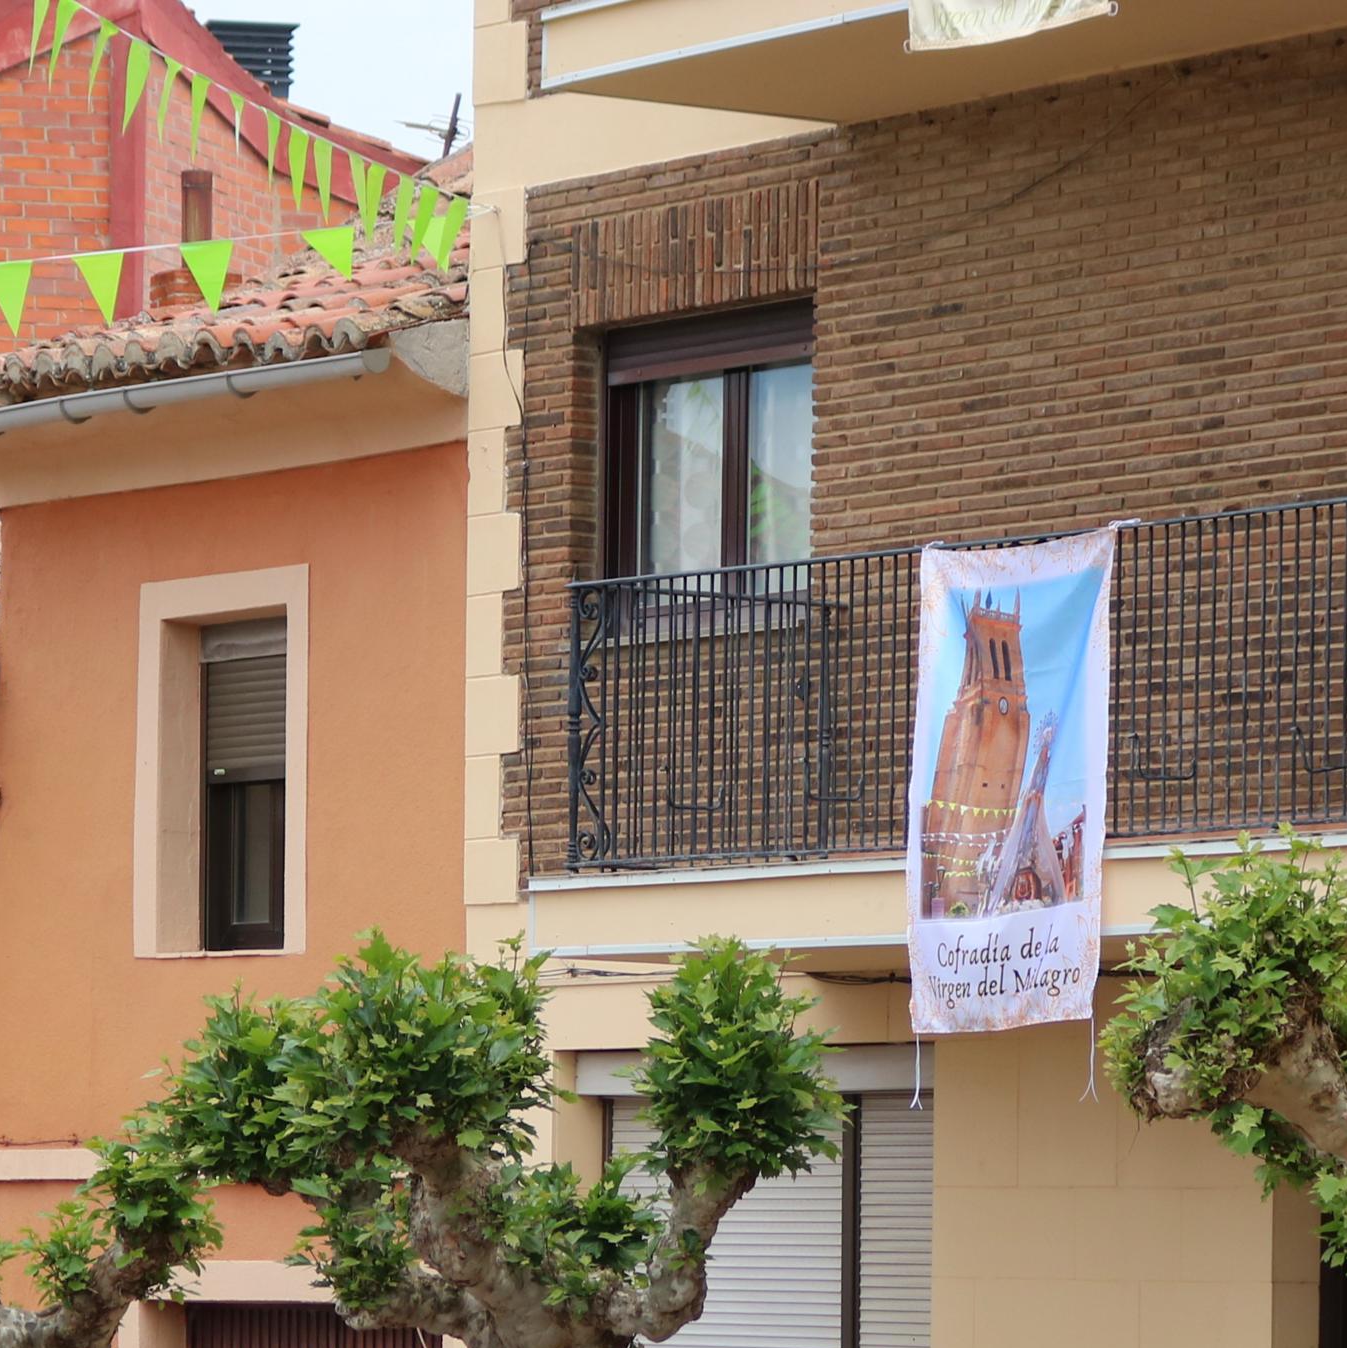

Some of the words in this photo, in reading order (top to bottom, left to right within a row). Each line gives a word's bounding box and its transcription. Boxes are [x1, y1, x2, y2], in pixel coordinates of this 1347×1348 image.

[937, 932, 1011, 974] Cofradía
[1020, 926, 1042, 960] de
[1045, 923, 1060, 954] la
[929, 975, 971, 1009] Virgen
[977, 963, 1005, 997] del
[1013, 957, 1081, 997] Milagro
